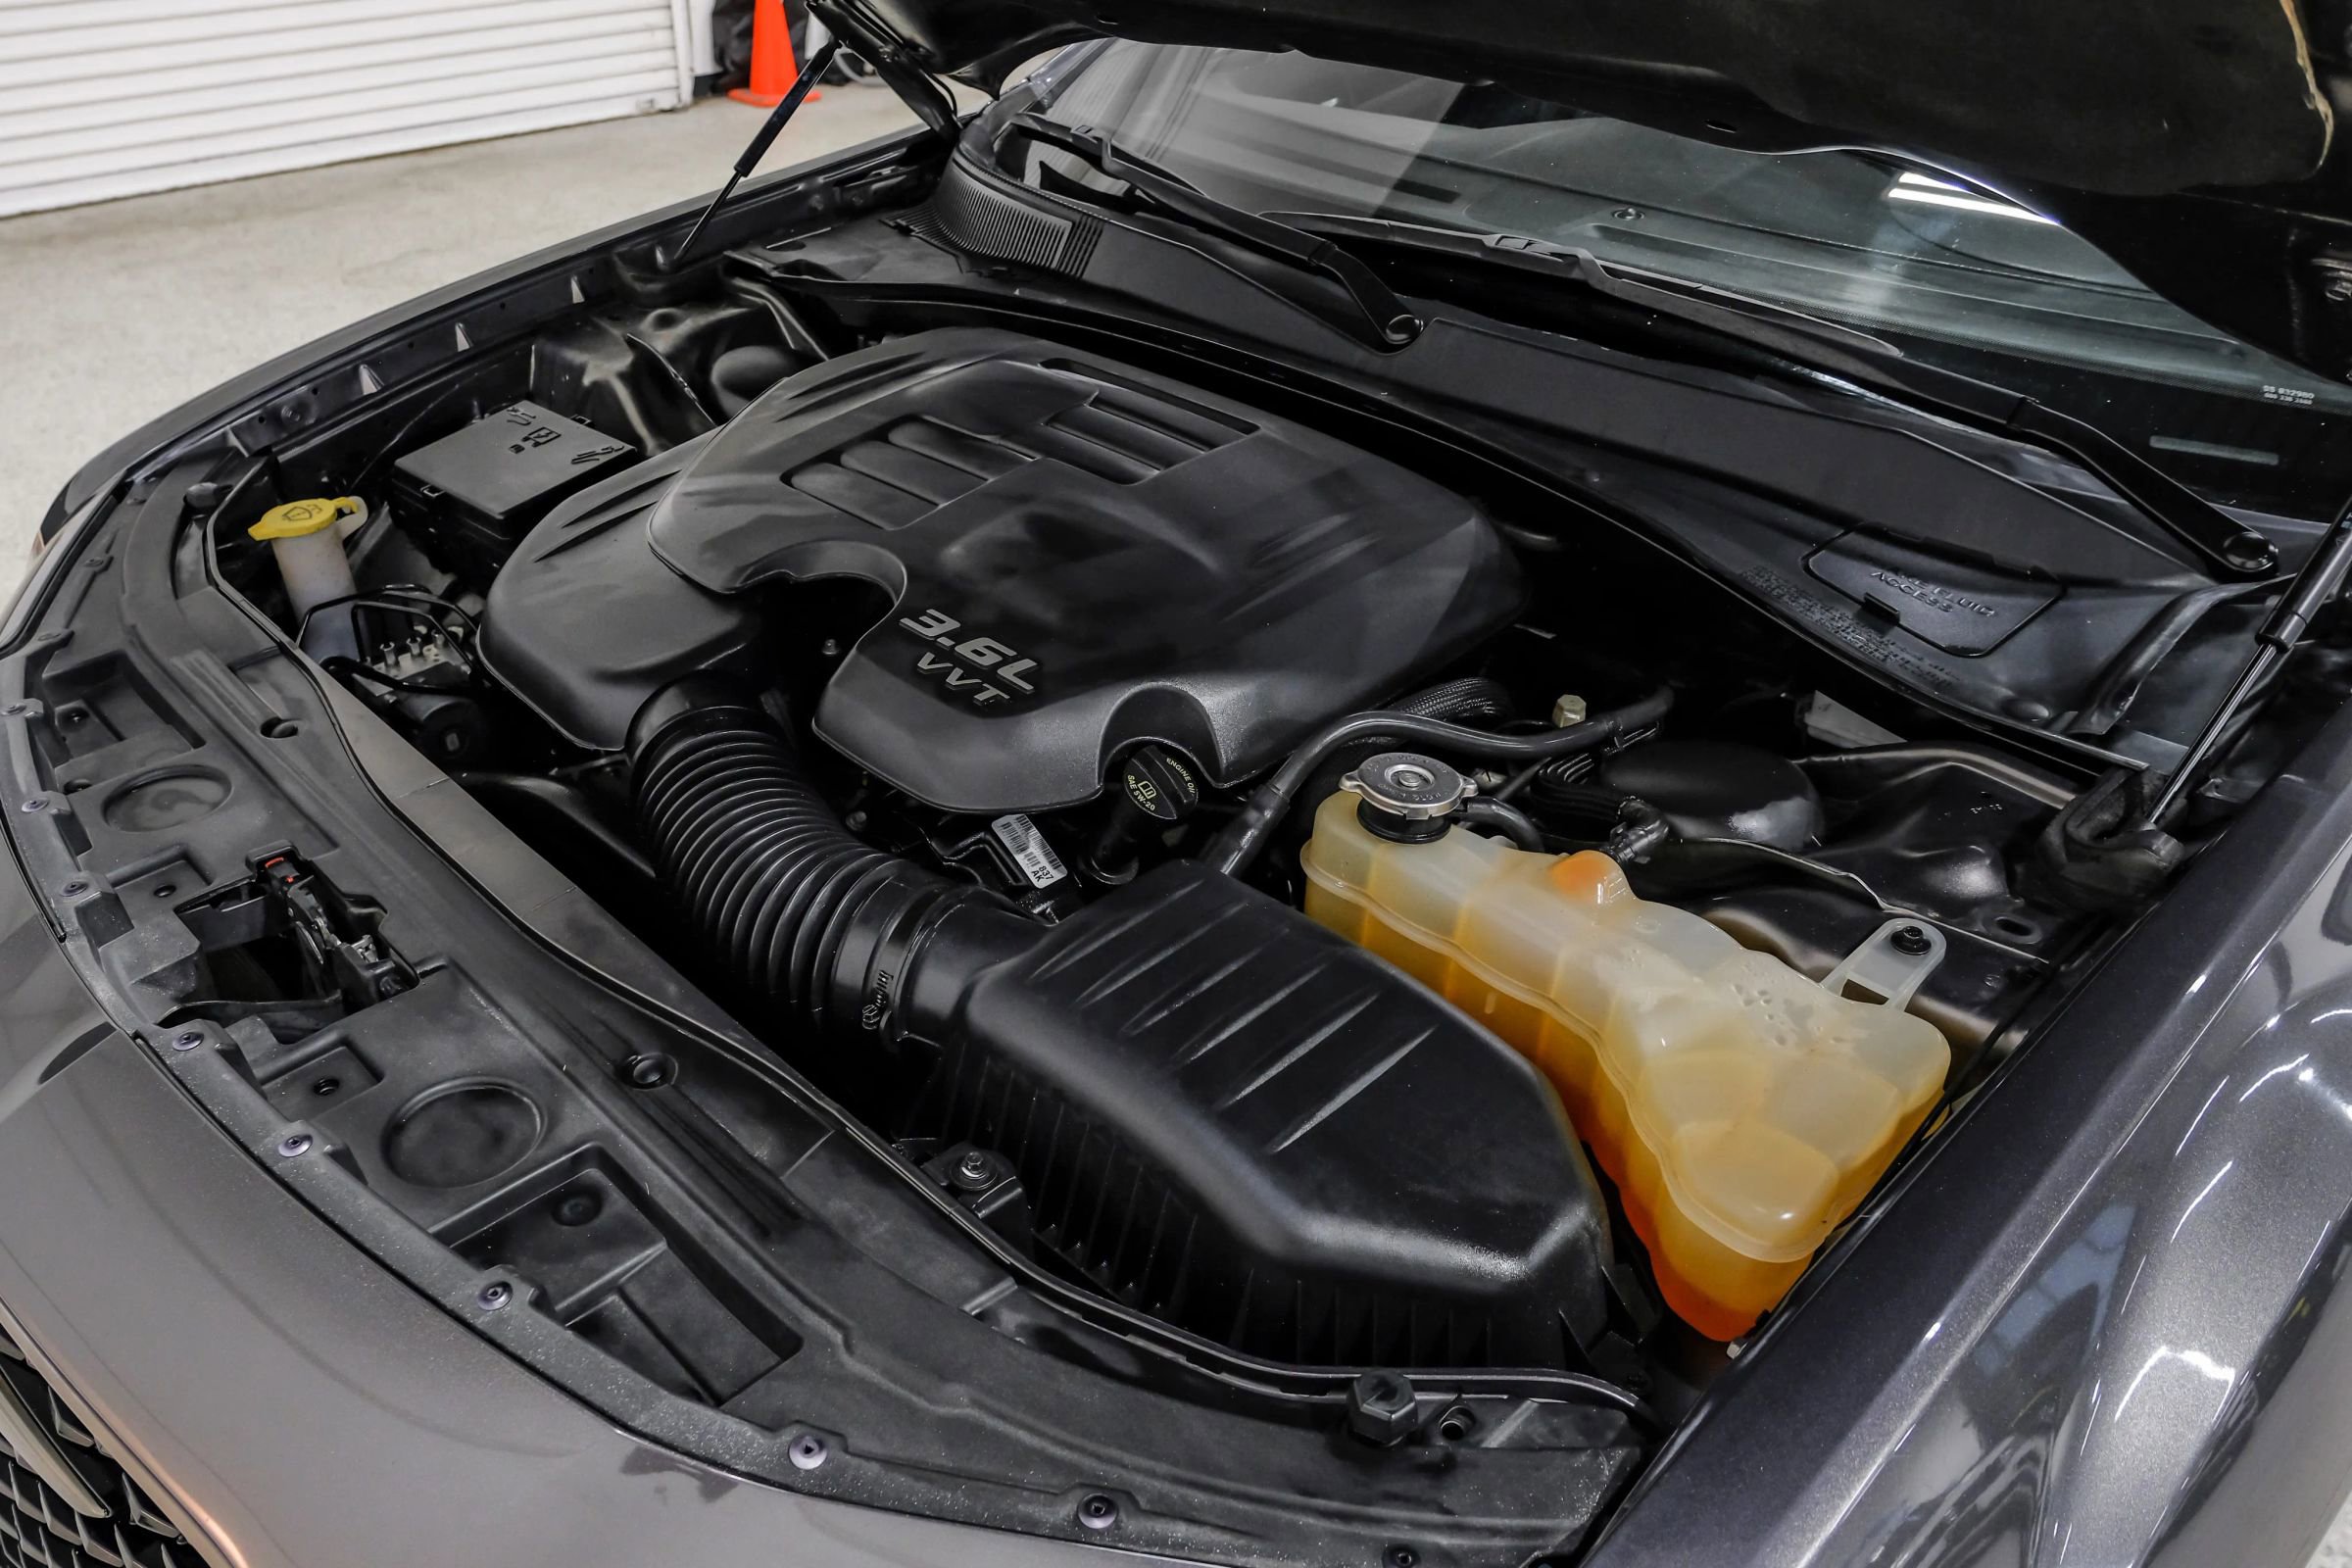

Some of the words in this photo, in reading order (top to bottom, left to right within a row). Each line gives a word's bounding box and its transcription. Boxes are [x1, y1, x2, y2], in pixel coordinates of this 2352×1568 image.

[1870, 571, 1952, 612] ACCESS
[899, 609, 1038, 693] 3.6L
[917, 652, 1010, 705] VVT
[1166, 757, 1192, 782] ENGINE
[1127, 774, 1137, 790] SAE
[1133, 790, 1155, 811] 5W-20
[1031, 869, 1045, 882] AK
[1039, 865, 1054, 880] 837
